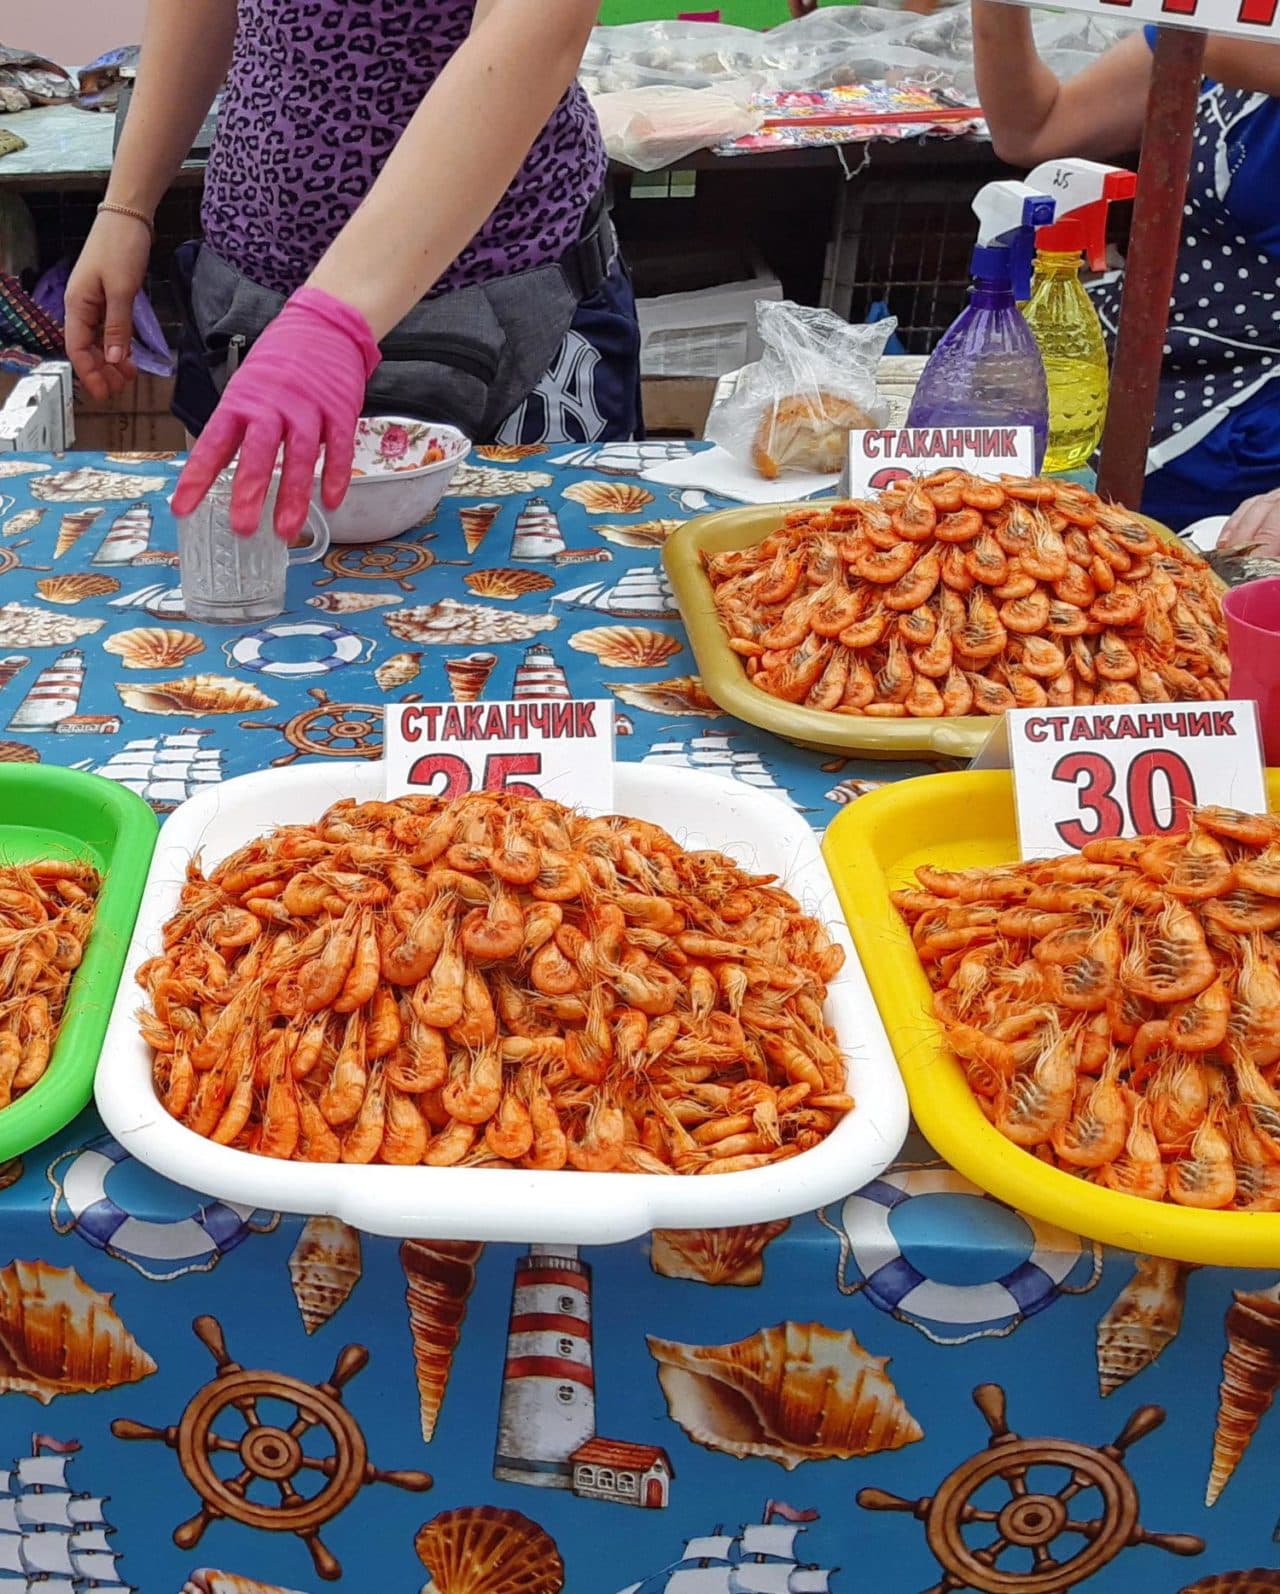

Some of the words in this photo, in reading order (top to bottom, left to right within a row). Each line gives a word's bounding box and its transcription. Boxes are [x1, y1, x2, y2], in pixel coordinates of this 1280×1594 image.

[862, 428, 1019, 459] СТАКАНЧИК
[400, 701, 597, 742] СТАКАНЧИК
[1023, 710, 1238, 743] СТАКАНЧИК
[1051, 748, 1199, 851] 30
